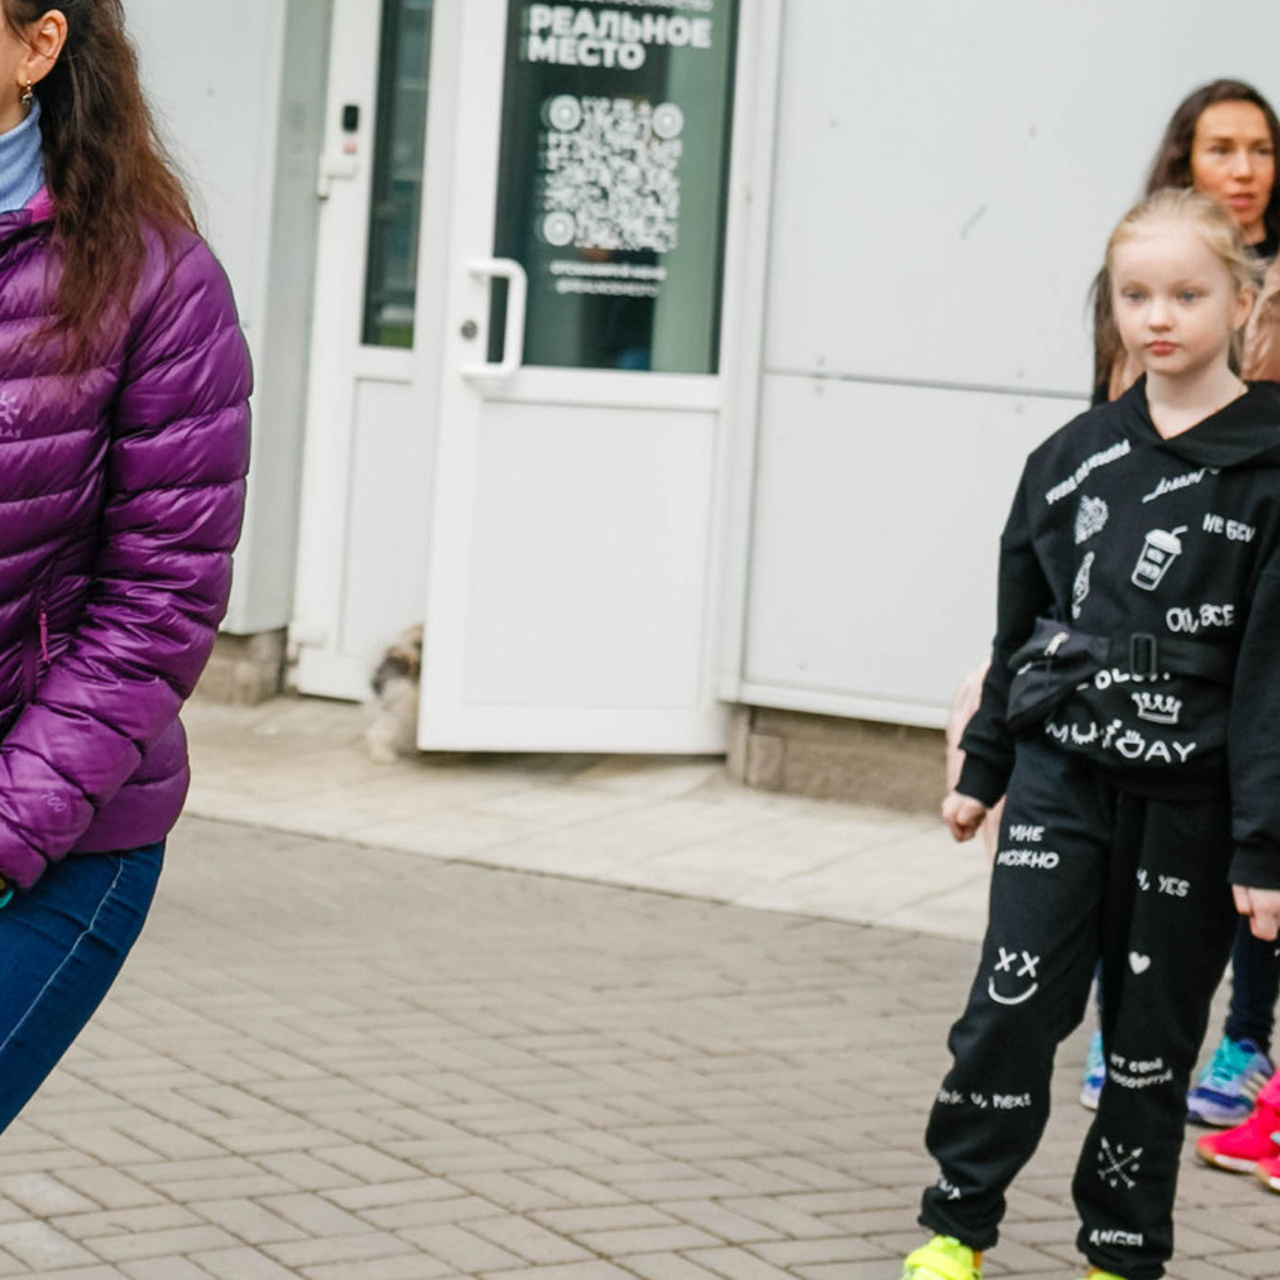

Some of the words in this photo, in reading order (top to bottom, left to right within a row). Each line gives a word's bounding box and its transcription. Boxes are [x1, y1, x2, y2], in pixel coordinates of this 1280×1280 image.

[529, 3, 712, 49] РЕАЛЬНОЕ
[528, 35, 646, 70] МЕСТО
[1009, 825, 1045, 842] МНЕ
[1158, 874, 1191, 897] YES
[993, 1093, 1032, 1110] next
